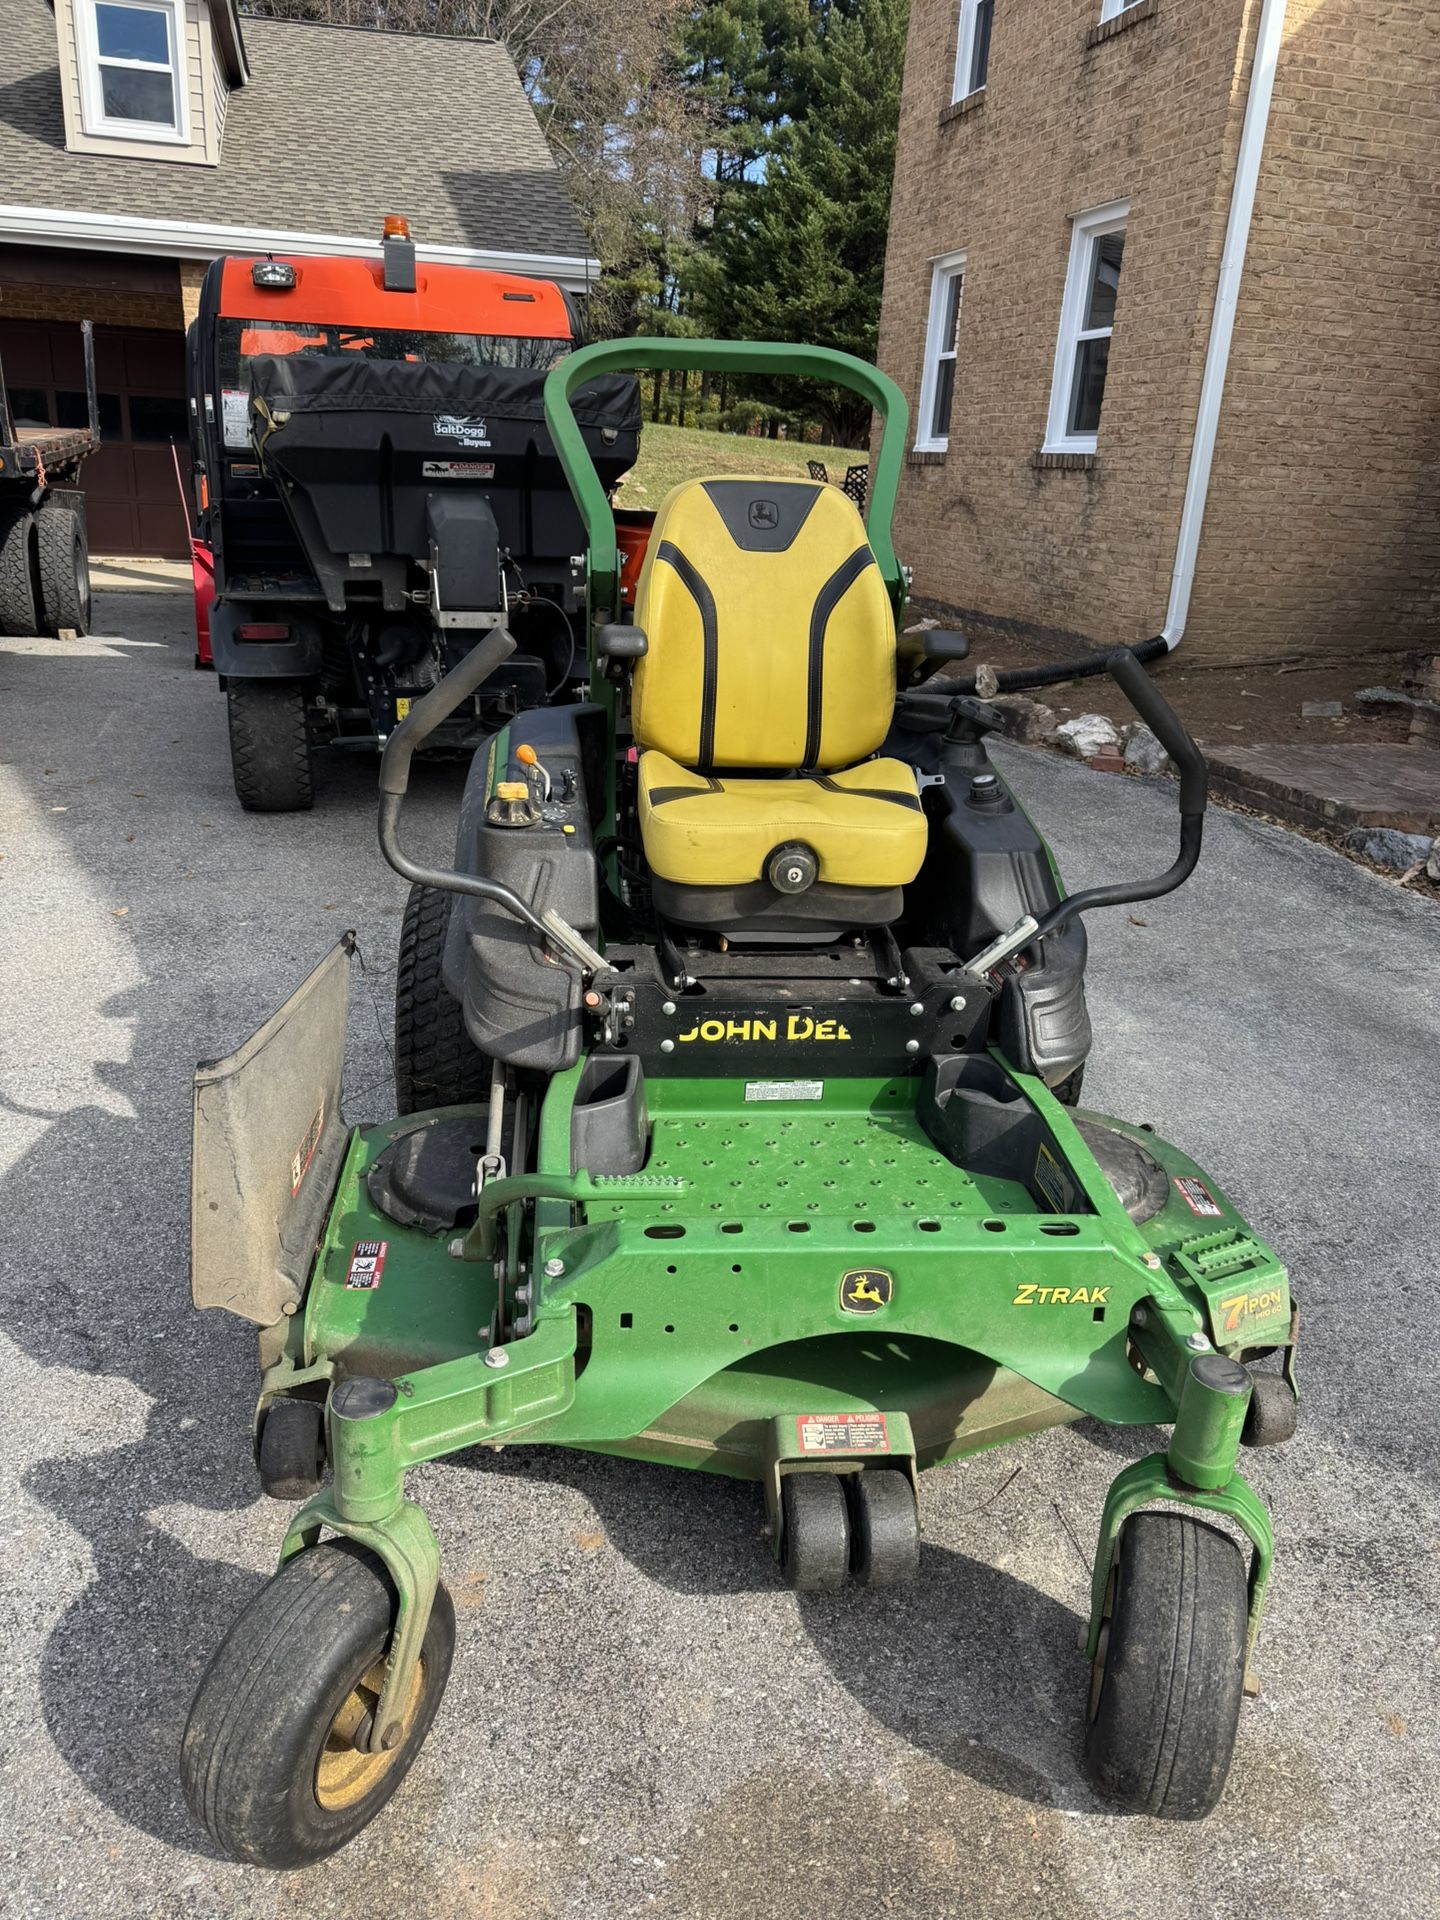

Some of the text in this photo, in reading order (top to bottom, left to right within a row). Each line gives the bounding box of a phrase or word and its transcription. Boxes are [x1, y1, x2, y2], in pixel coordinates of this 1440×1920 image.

[436, 424, 484, 437] SaltDogg
[463, 438, 491, 448] Buyers
[1012, 1283, 1112, 1304] ZTRAK
